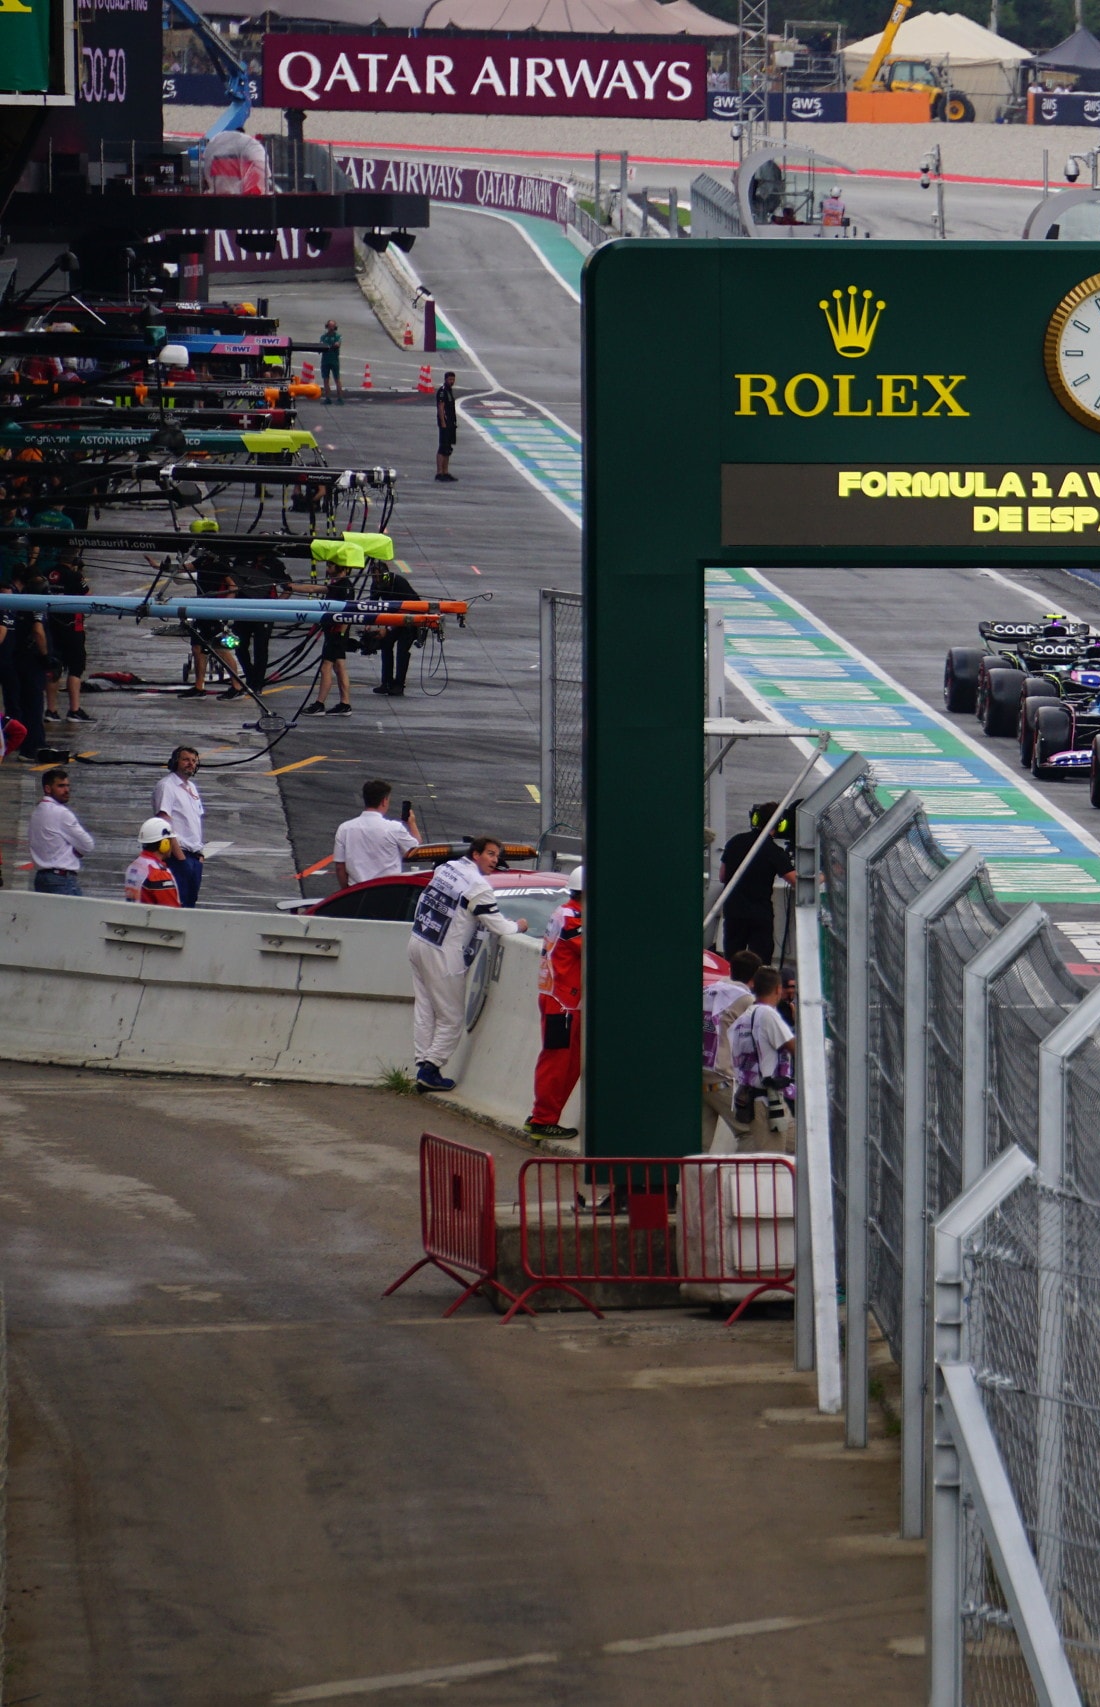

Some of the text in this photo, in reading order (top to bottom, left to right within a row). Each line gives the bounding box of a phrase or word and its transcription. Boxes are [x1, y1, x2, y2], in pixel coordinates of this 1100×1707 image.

[278, 51, 692, 101] QATAR AIRWAYS
[791, 97, 822, 109] aws
[381, 161, 463, 198] AIRWAYS
[476, 170, 515, 206] QATAR
[734, 372, 970, 417] ROLEX
[80, 435, 114, 445] ASTON
[838, 470, 1026, 498] FORMULA
[1032, 471, 1052, 498] 1
[973, 506, 1023, 532] DE
[332, 613, 365, 624] Gulf
[357, 601, 390, 611] Gulf
